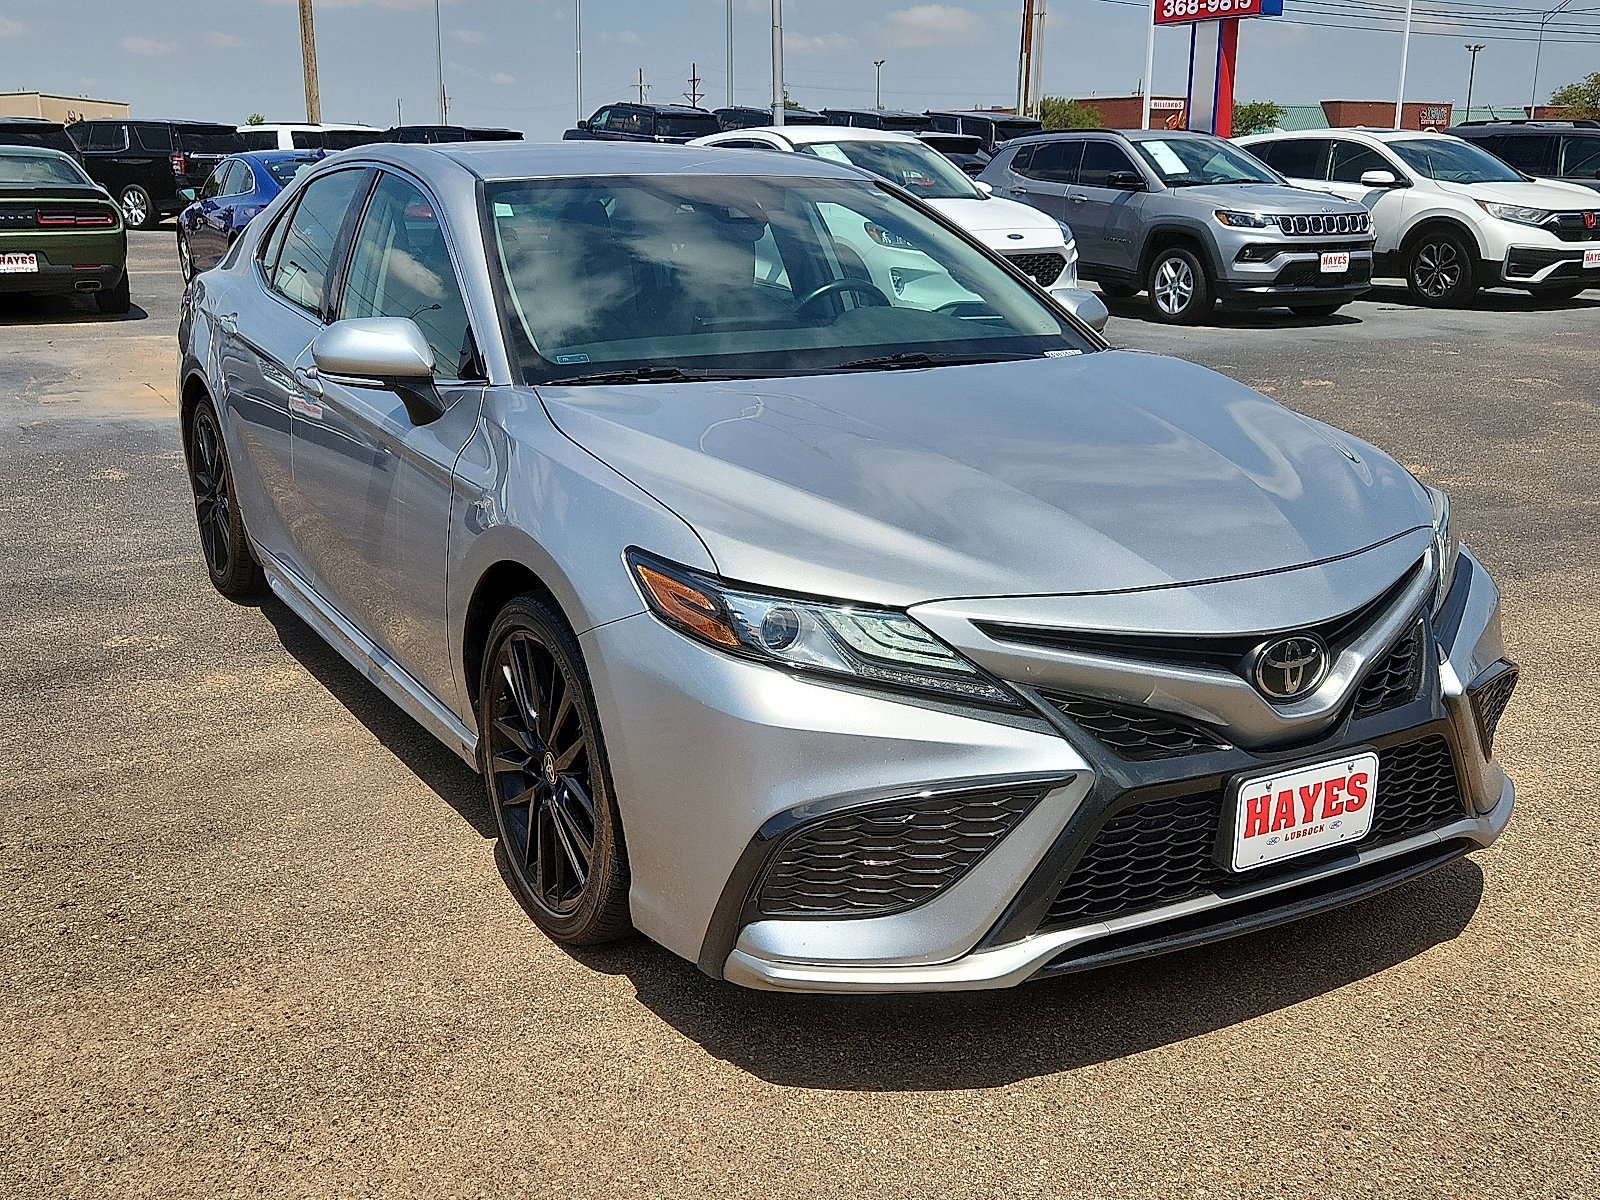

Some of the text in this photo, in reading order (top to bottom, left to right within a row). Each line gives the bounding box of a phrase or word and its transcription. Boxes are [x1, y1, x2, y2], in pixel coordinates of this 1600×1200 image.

[0, 256, 35, 265] HAYES
[1322, 255, 1347, 265] HAYES
[1243, 772, 1369, 840] HAYES
[1284, 824, 1325, 842] LUBBOCK
